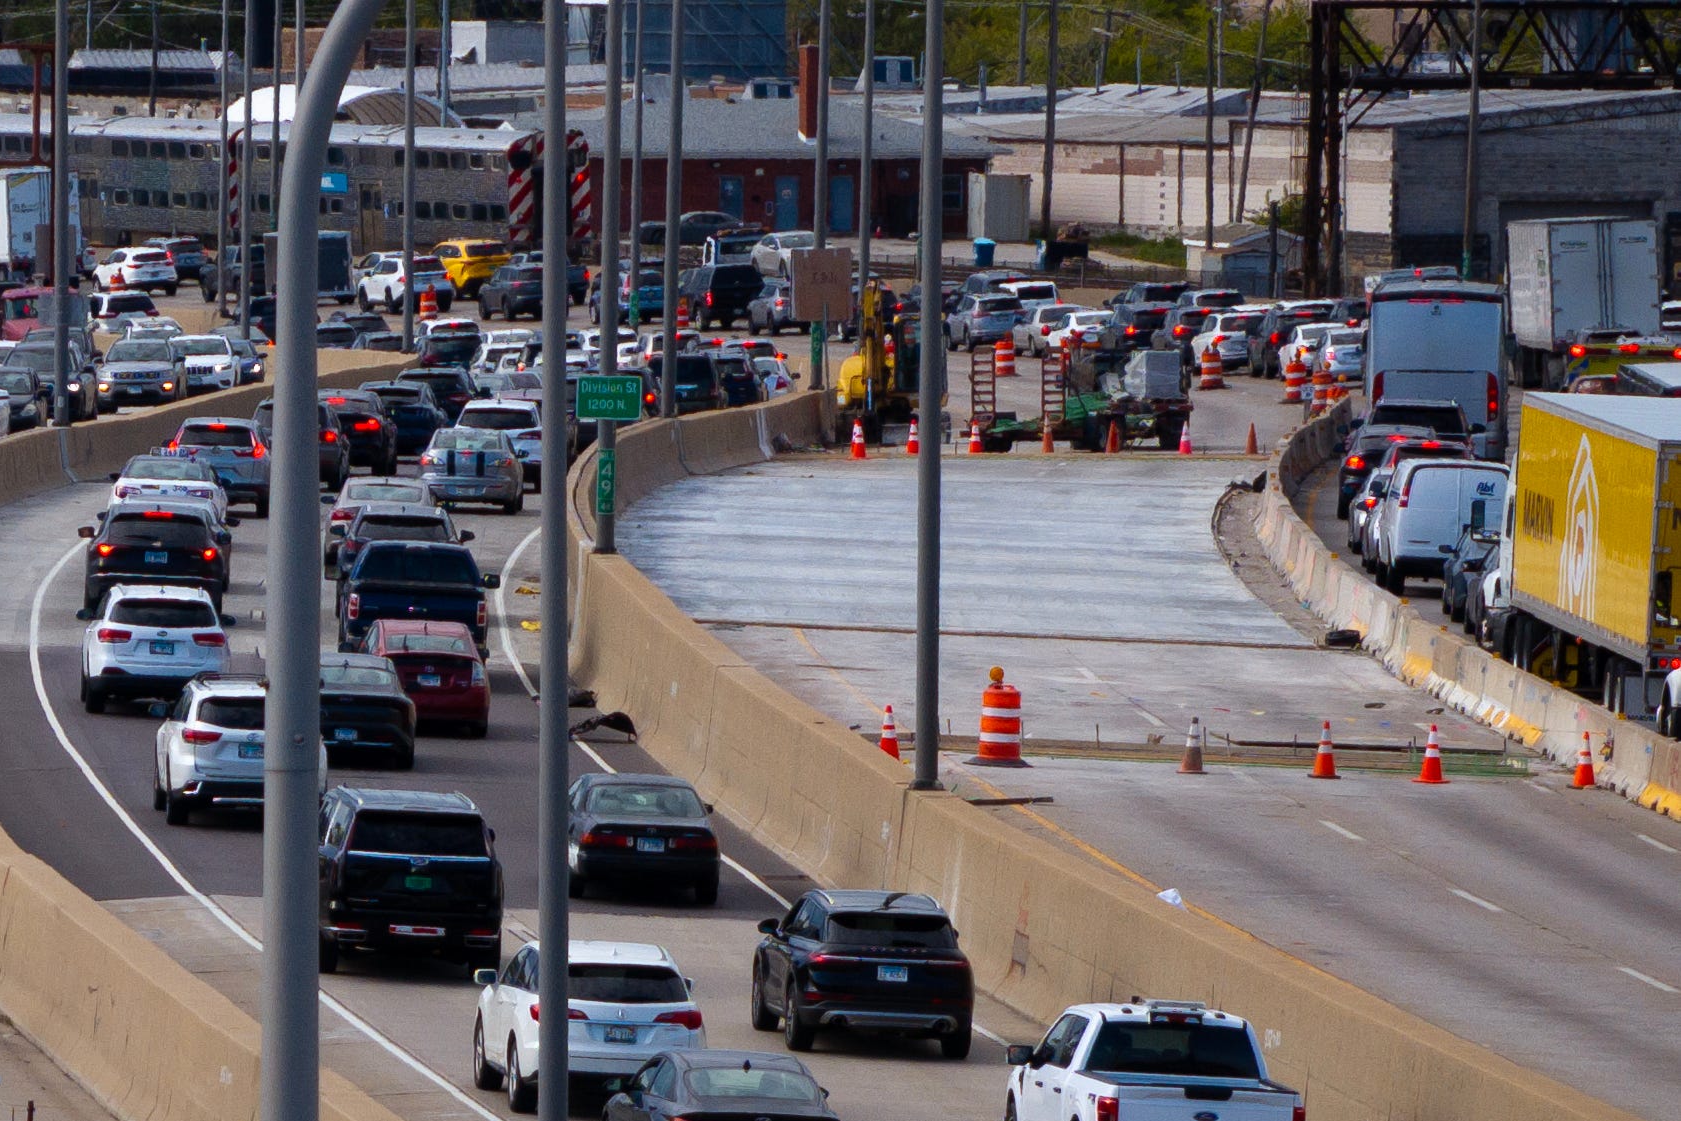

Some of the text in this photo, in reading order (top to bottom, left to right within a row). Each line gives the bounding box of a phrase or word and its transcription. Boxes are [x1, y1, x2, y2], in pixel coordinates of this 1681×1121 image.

[581, 381, 637, 394] Division St
[588, 399, 614, 410] 1200
[1523, 488, 1555, 545] MARVIN
